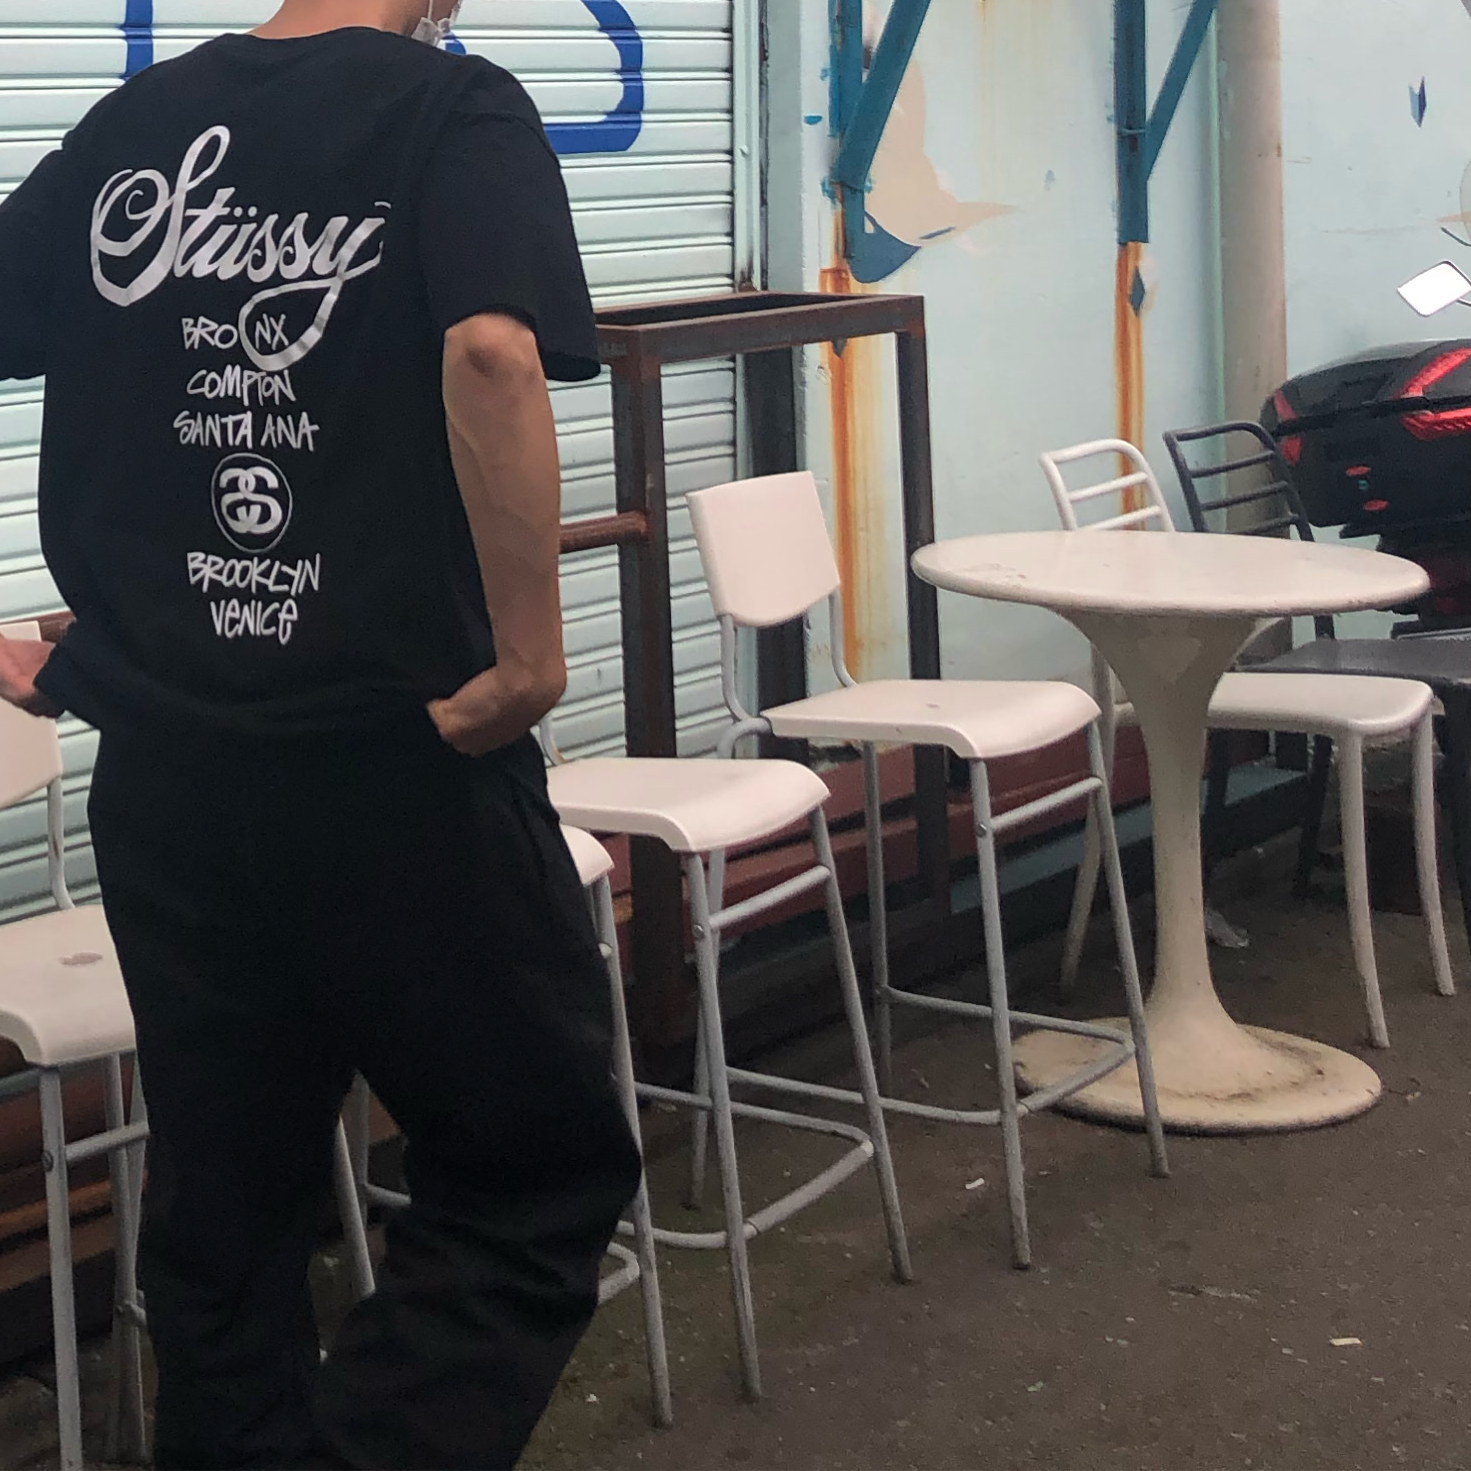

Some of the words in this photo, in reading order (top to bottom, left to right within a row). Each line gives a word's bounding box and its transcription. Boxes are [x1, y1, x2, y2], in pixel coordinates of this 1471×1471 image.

[186, 363, 297, 407] COMPTON
[173, 410, 253, 450] SANTA
[260, 411, 320, 452] ANA
[186, 551, 321, 597] BROOKLYN
